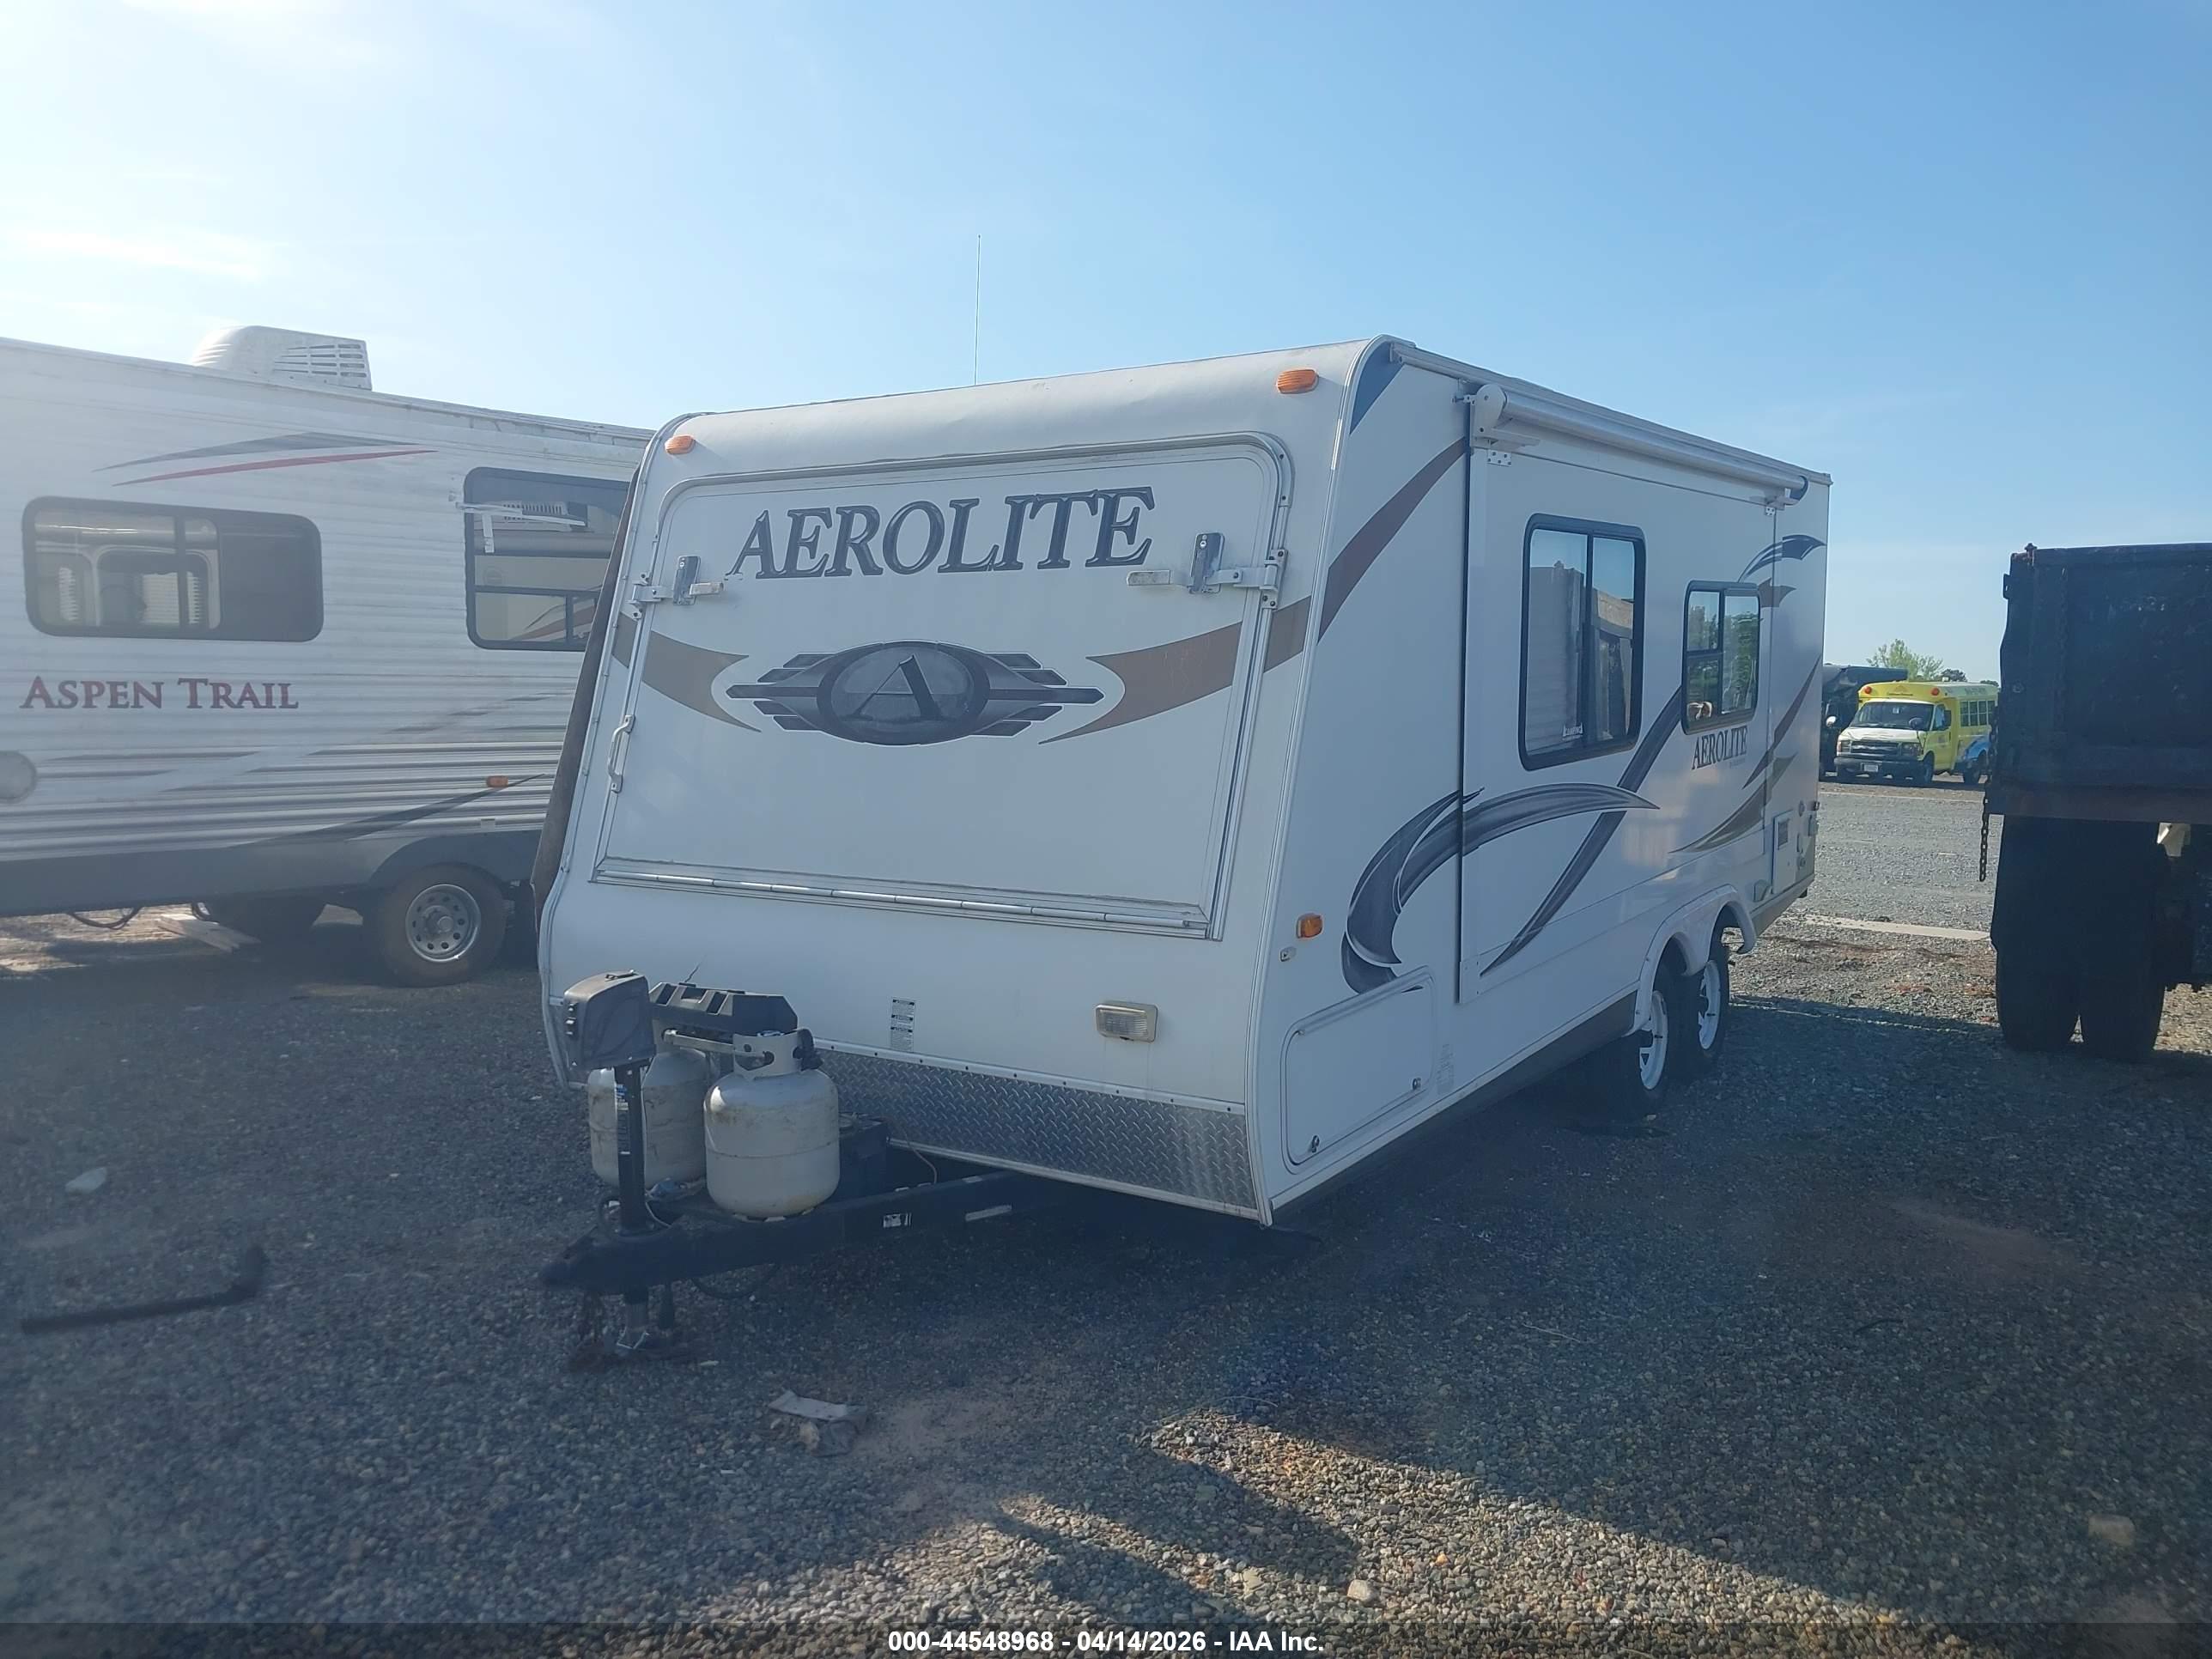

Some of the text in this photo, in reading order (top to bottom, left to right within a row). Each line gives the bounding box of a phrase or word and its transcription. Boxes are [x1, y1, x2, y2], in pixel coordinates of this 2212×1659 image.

[725, 486, 1155, 580] AEROLITE
[19, 675, 299, 709] ASPEN TRAIL
[845, 654, 946, 723] A
[1692, 725, 1748, 770] AEROLITE
